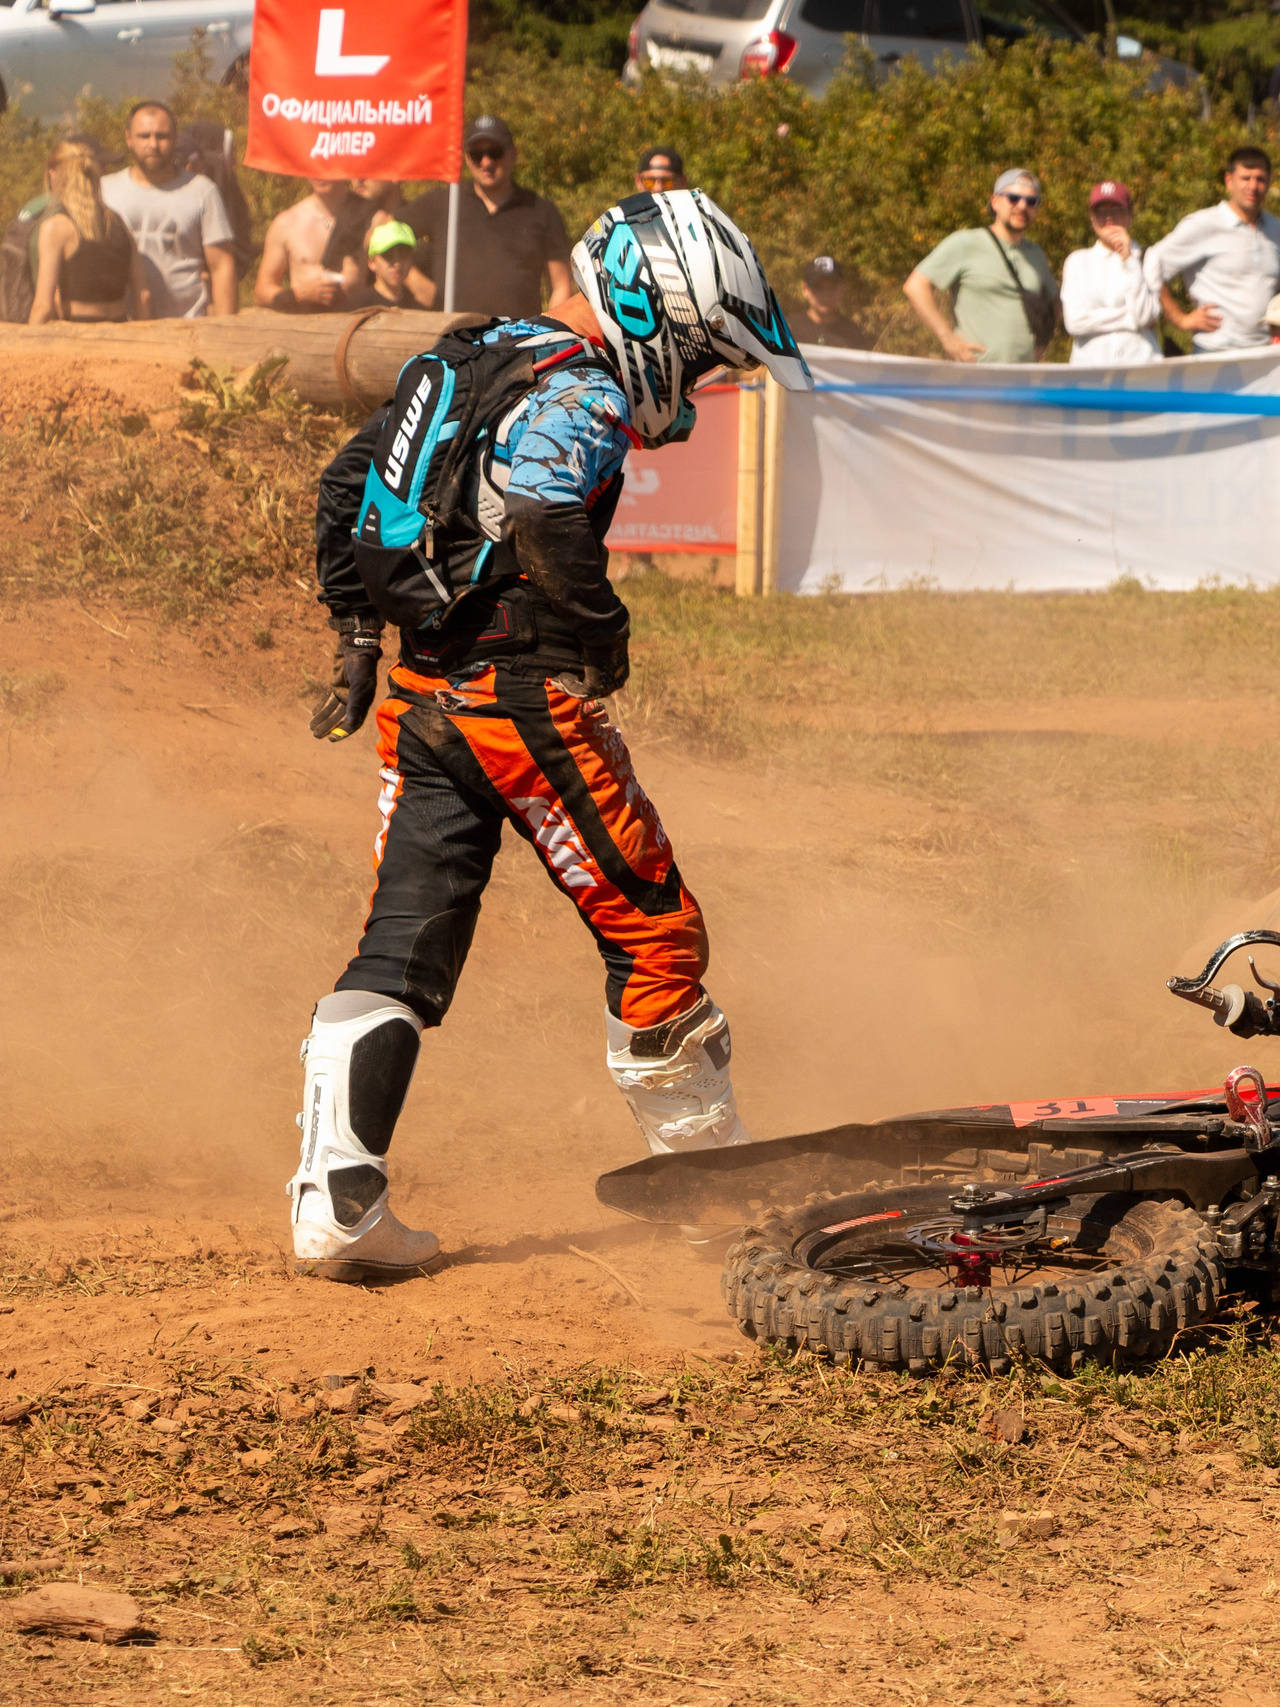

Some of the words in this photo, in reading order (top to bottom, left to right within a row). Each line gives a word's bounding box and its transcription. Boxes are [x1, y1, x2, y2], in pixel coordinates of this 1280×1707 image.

[261, 93, 433, 128] ОФИЦИАЛЬНЫЙ
[309, 131, 376, 160] ДИЛЕР
[642, 239, 713, 362] 100%
[383, 373, 433, 490] USWE
[509, 795, 599, 888] KTM
[1033, 1100, 1096, 1116] 31
